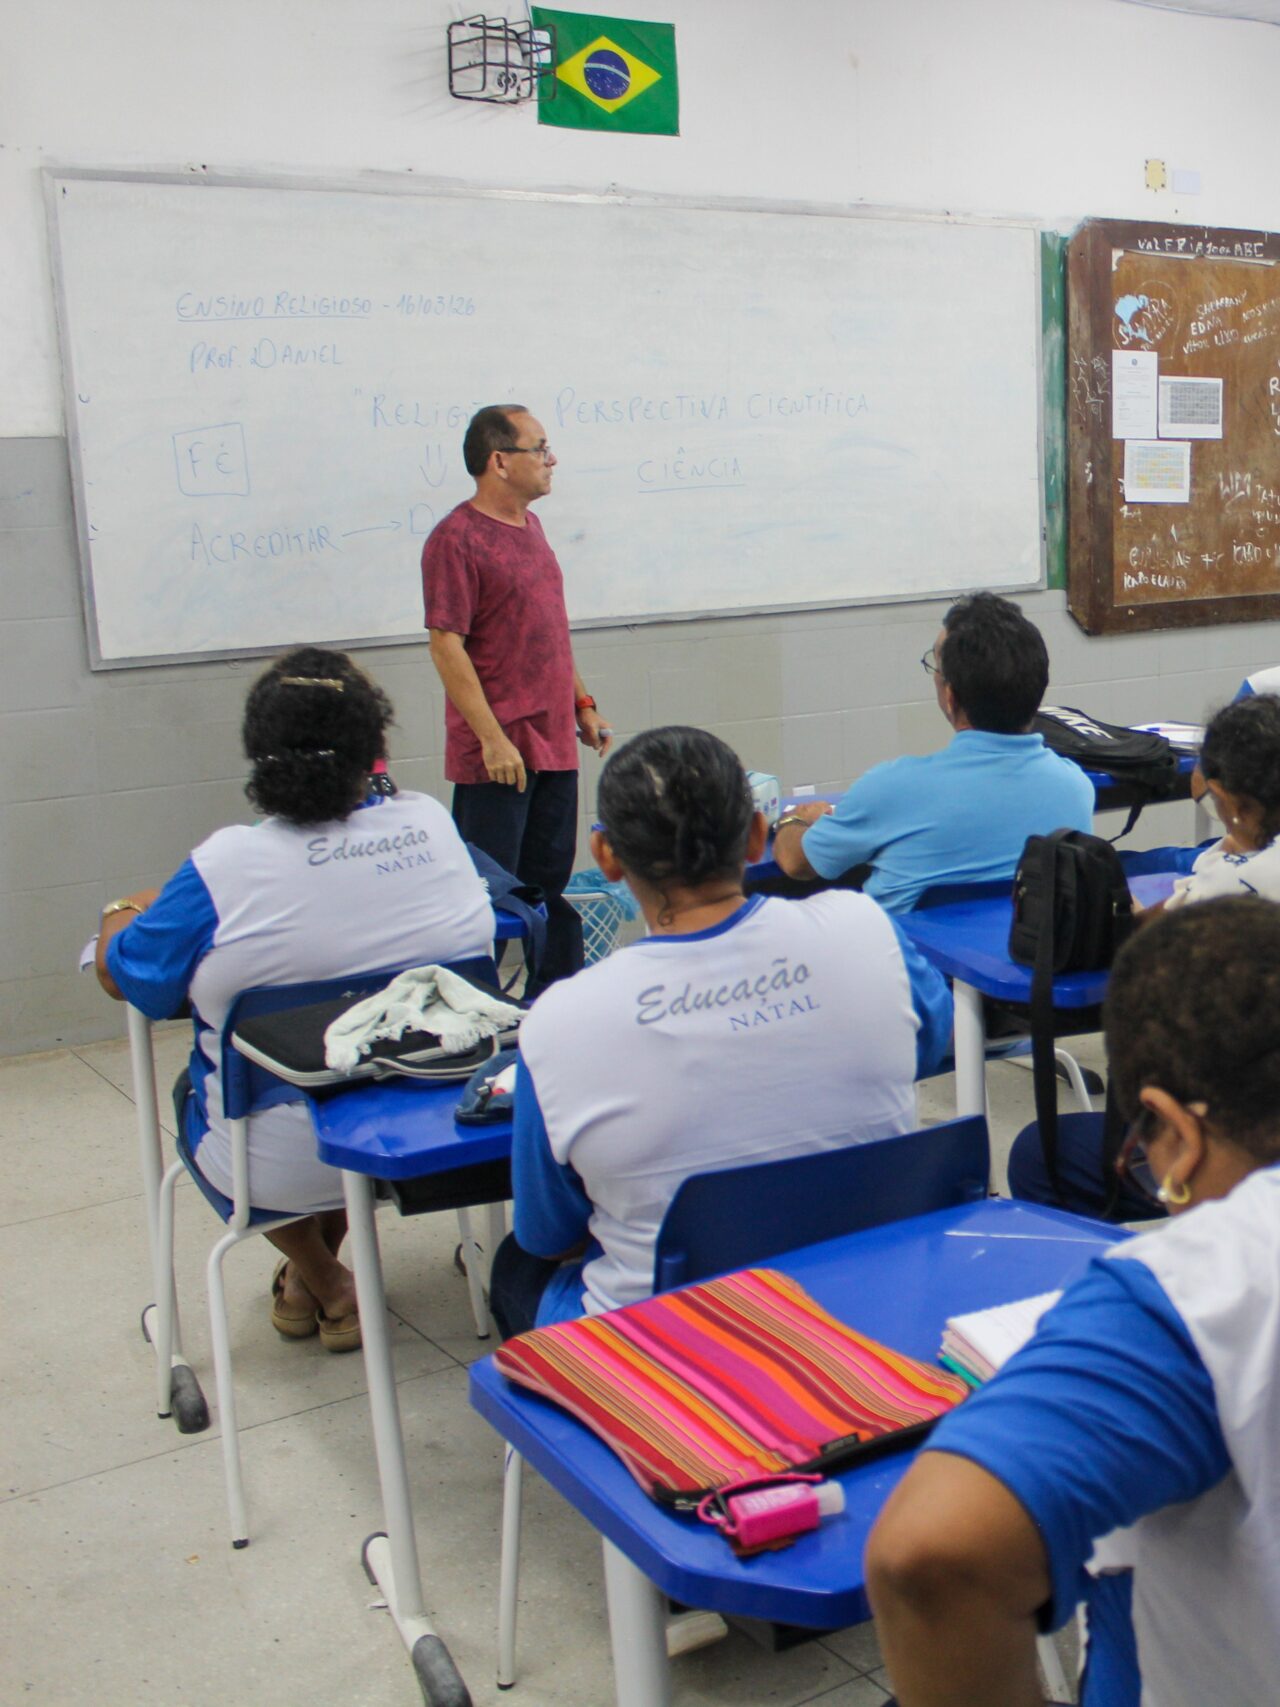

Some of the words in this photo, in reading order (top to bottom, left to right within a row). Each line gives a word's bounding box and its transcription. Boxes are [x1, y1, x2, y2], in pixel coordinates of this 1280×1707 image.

[306, 825, 430, 867] Educação
[375, 851, 437, 875] NATAL
[636, 957, 811, 1026] Educação
[729, 994, 822, 1031] NATAL
